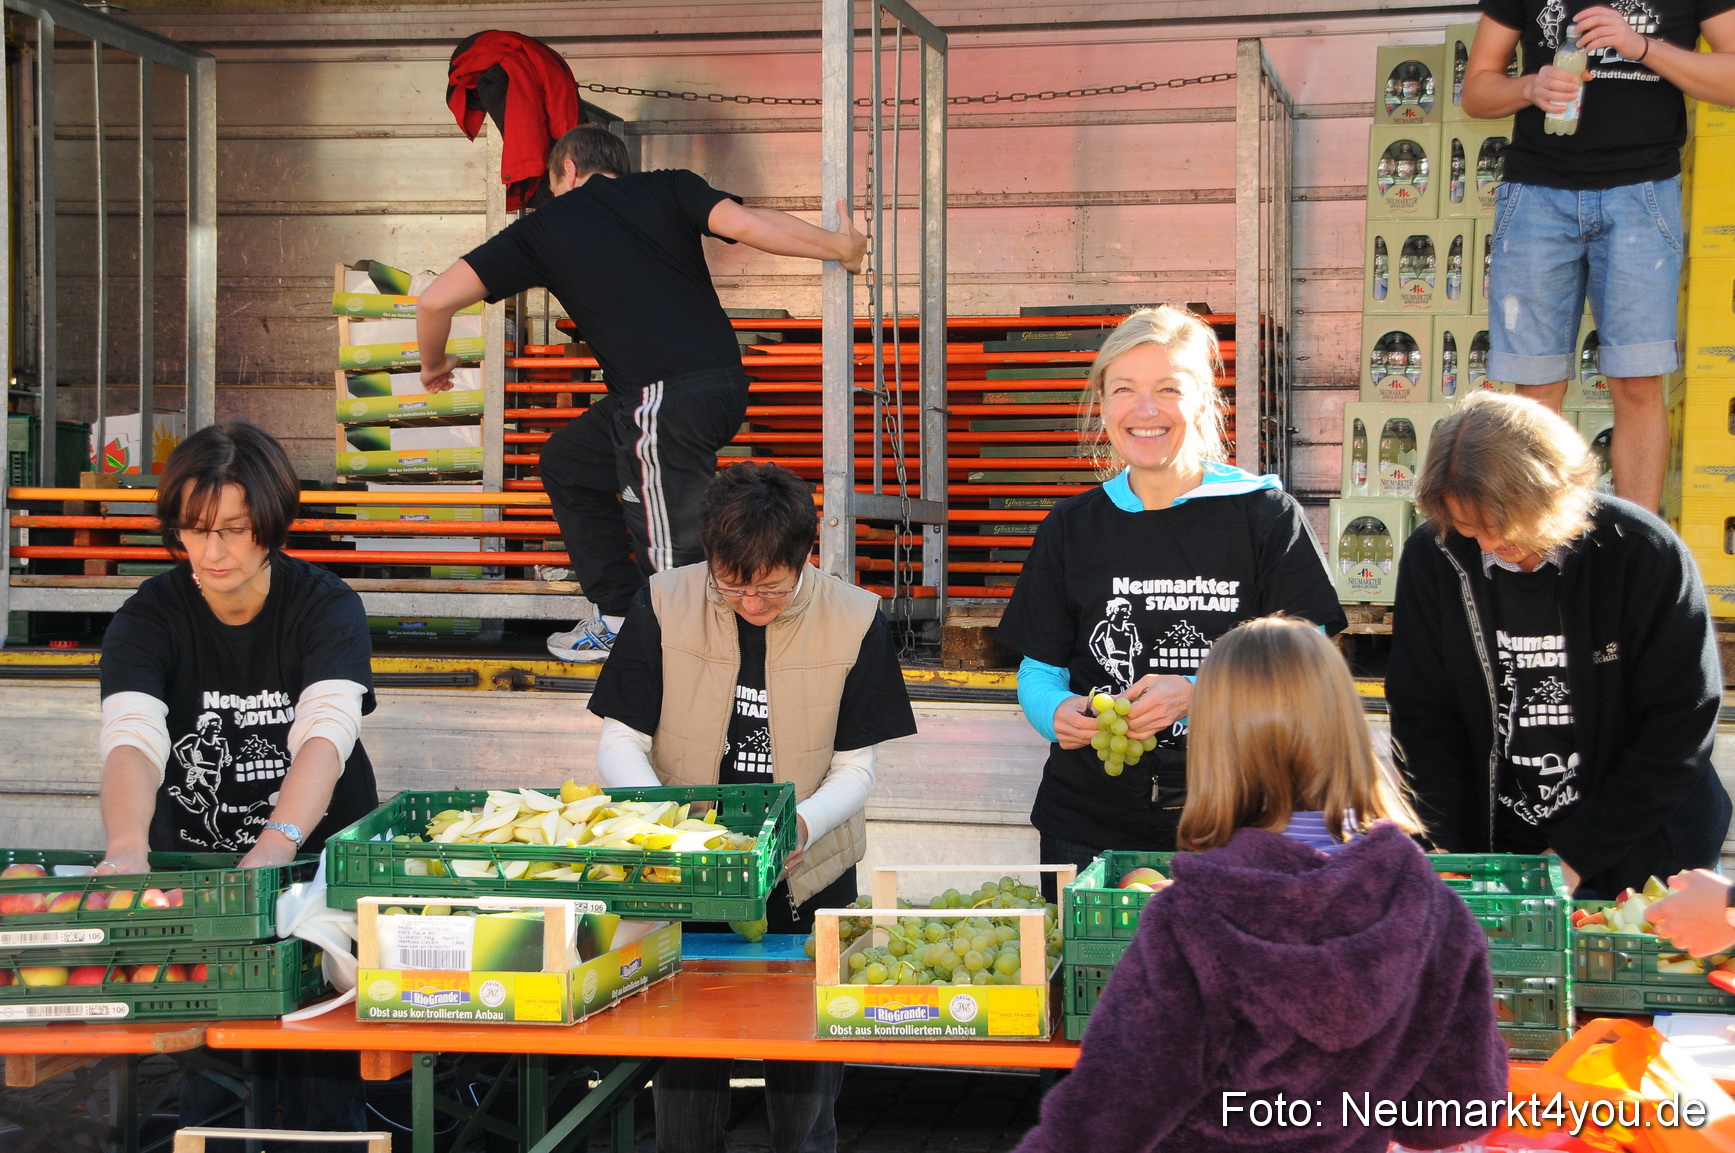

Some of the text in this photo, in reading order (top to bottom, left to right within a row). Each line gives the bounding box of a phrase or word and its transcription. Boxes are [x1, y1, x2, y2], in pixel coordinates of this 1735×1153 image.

[1590, 70, 1660, 82] Stadtlaufteam
[1112, 576, 1240, 595] Neumarkter
[1348, 577, 1382, 586] NEUMARKTER
[1145, 596, 1240, 612] STADTLAUF
[1516, 652, 1567, 668] STADT
[203, 690, 291, 711] Neumarkte
[590, 904, 604, 912] 106
[402, 978, 470, 992] EDEKA
[413, 992, 459, 1005] RioGrande
[864, 993, 938, 1007] EDEKA
[369, 1007, 390, 1018] Obst
[392, 1010, 408, 1018] aus
[410, 1008, 473, 1019] kontrolliertem
[475, 1008, 504, 1020] Anbau
[877, 1006, 927, 1021] RioGrande
[830, 1024, 853, 1035] Obst
[855, 1027, 872, 1035] aus
[874, 1024, 942, 1036] kontrolliertem
[945, 1025, 976, 1035] Anbau
